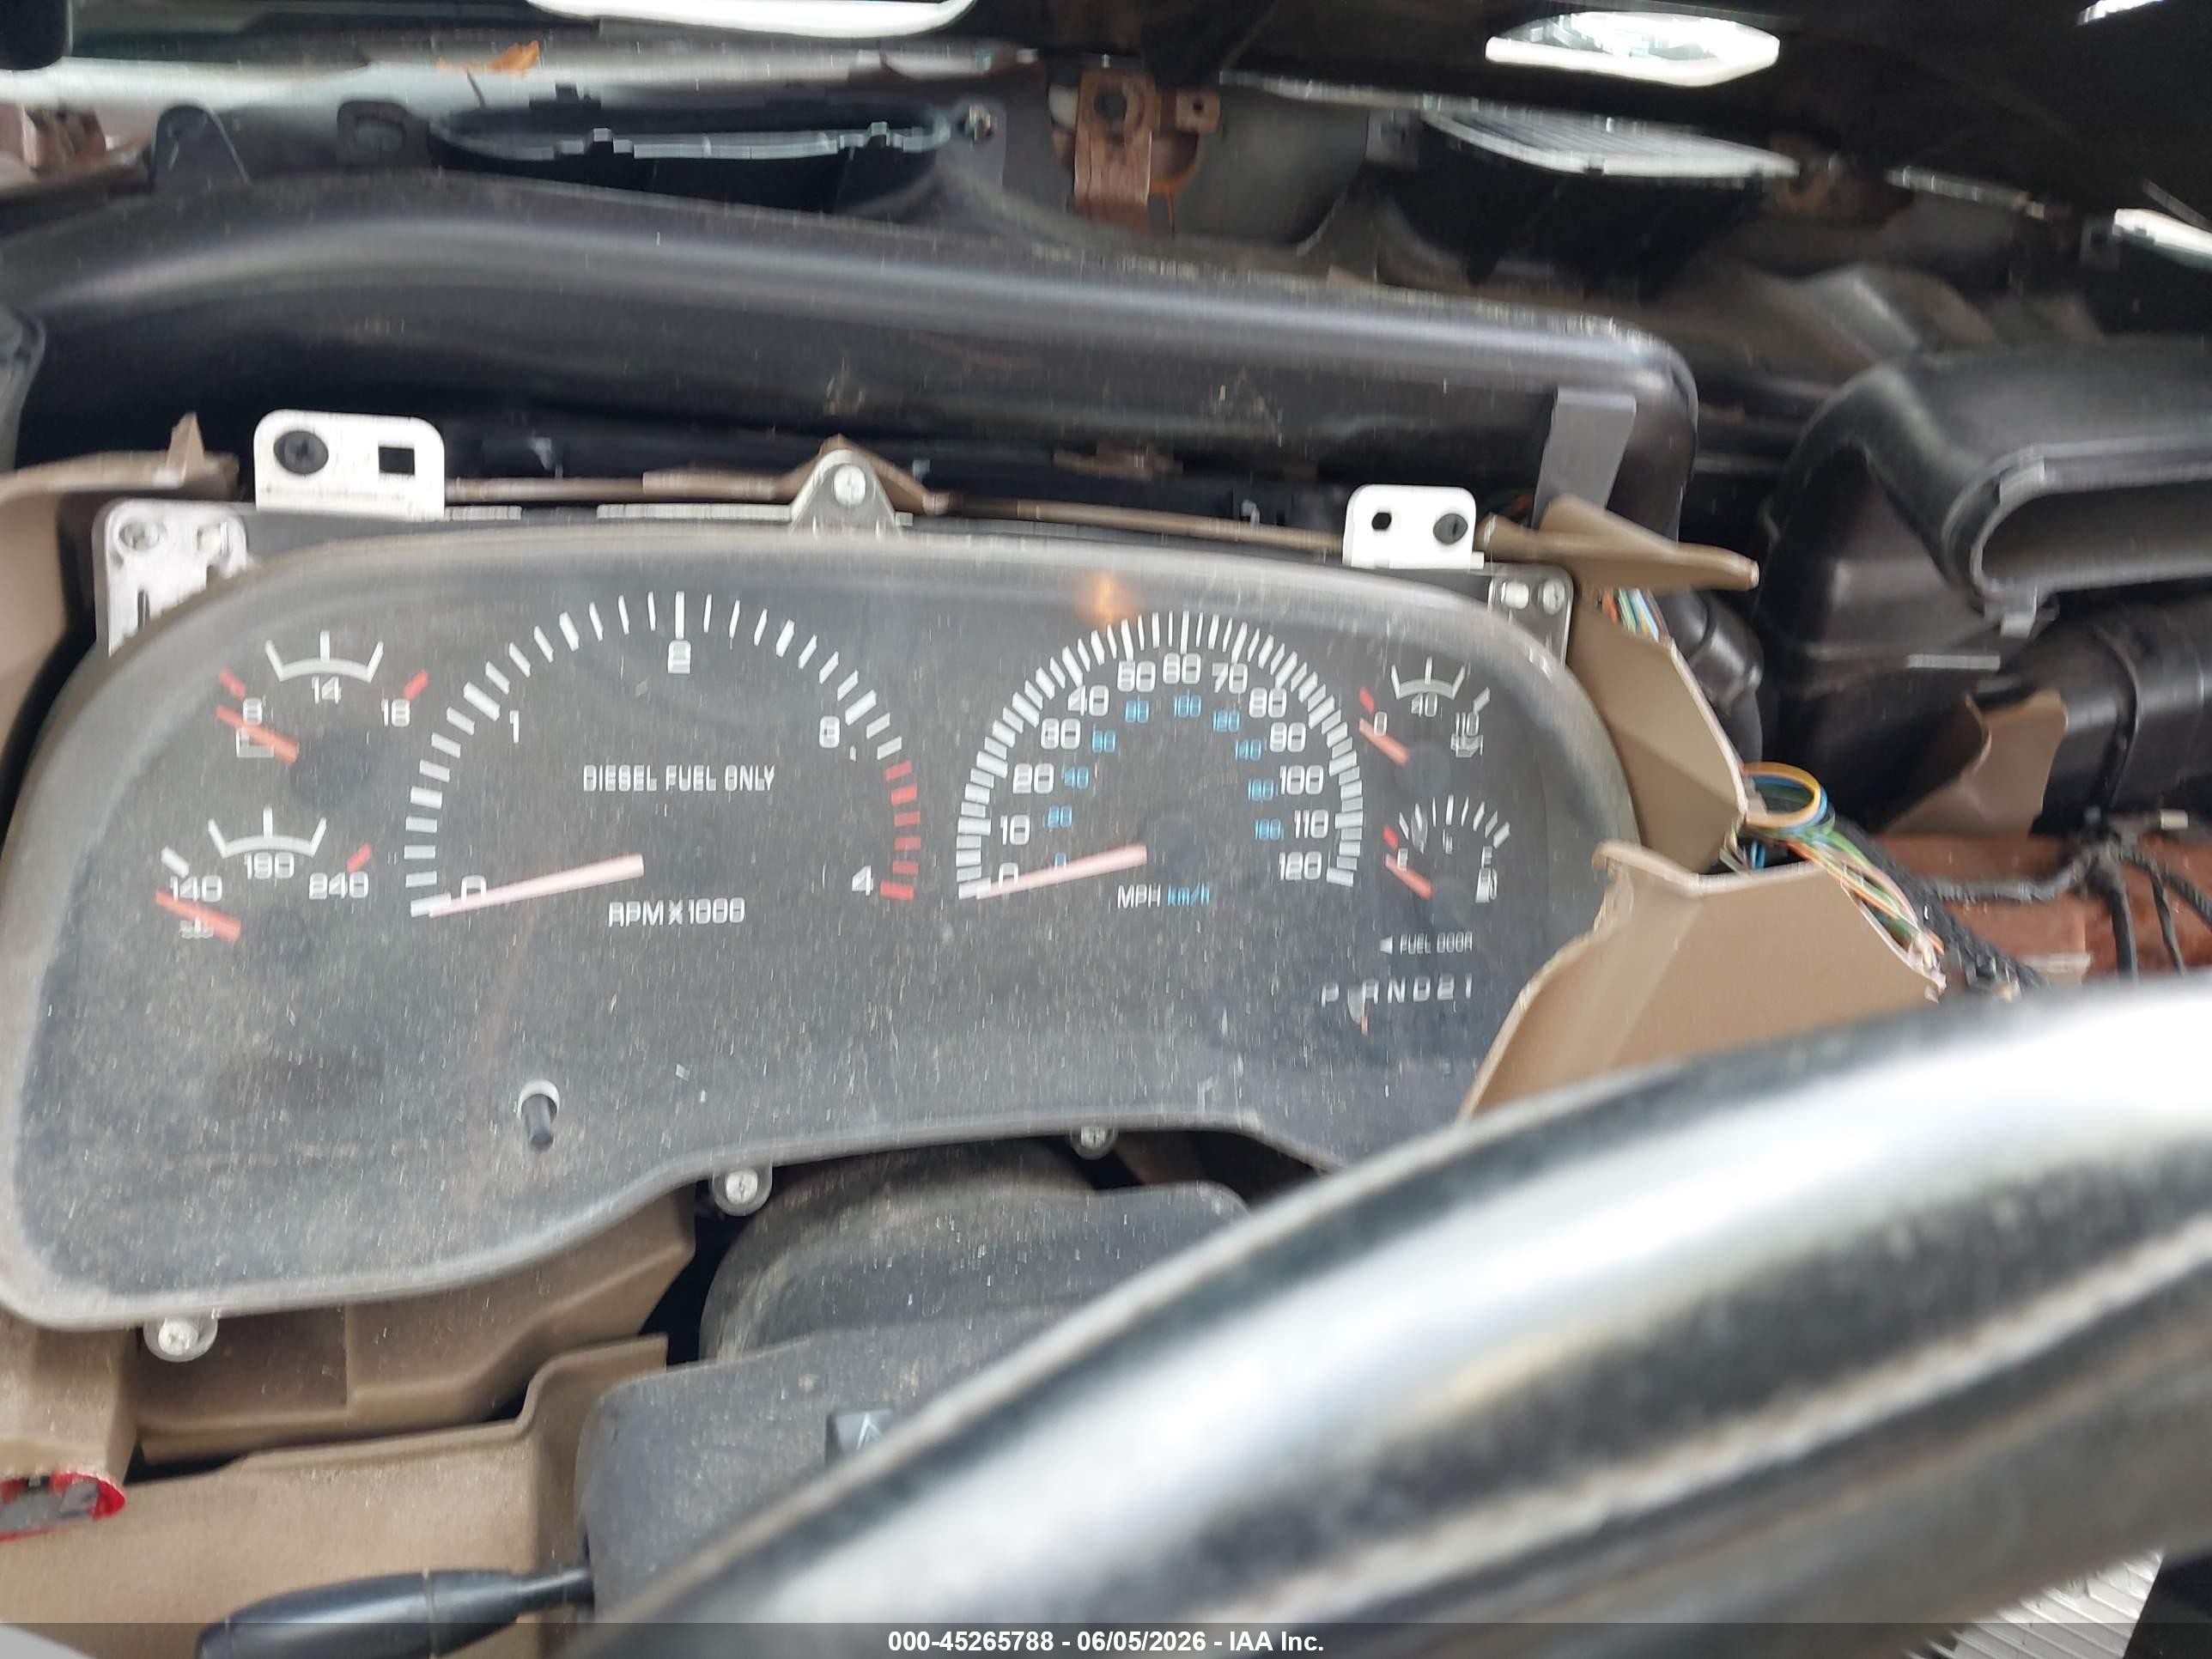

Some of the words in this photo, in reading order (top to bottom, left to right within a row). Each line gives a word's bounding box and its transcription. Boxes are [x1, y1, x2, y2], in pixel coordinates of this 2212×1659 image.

[312, 676, 341, 704] 14
[1212, 663, 1248, 694] 70
[1067, 684, 1109, 716] 40
[509, 710, 519, 743] 1
[583, 764, 658, 792] DIESEL
[665, 764, 716, 792] FUEL
[724, 764, 775, 792] ONLY
[1279, 765, 1324, 795] 100
[1000, 815, 1030, 846] 10
[1294, 810, 1329, 839] 110
[170, 875, 223, 902] 140
[851, 866, 874, 896] 4
[1117, 884, 1161, 909] MPH
[608, 900, 665, 927] RPM
